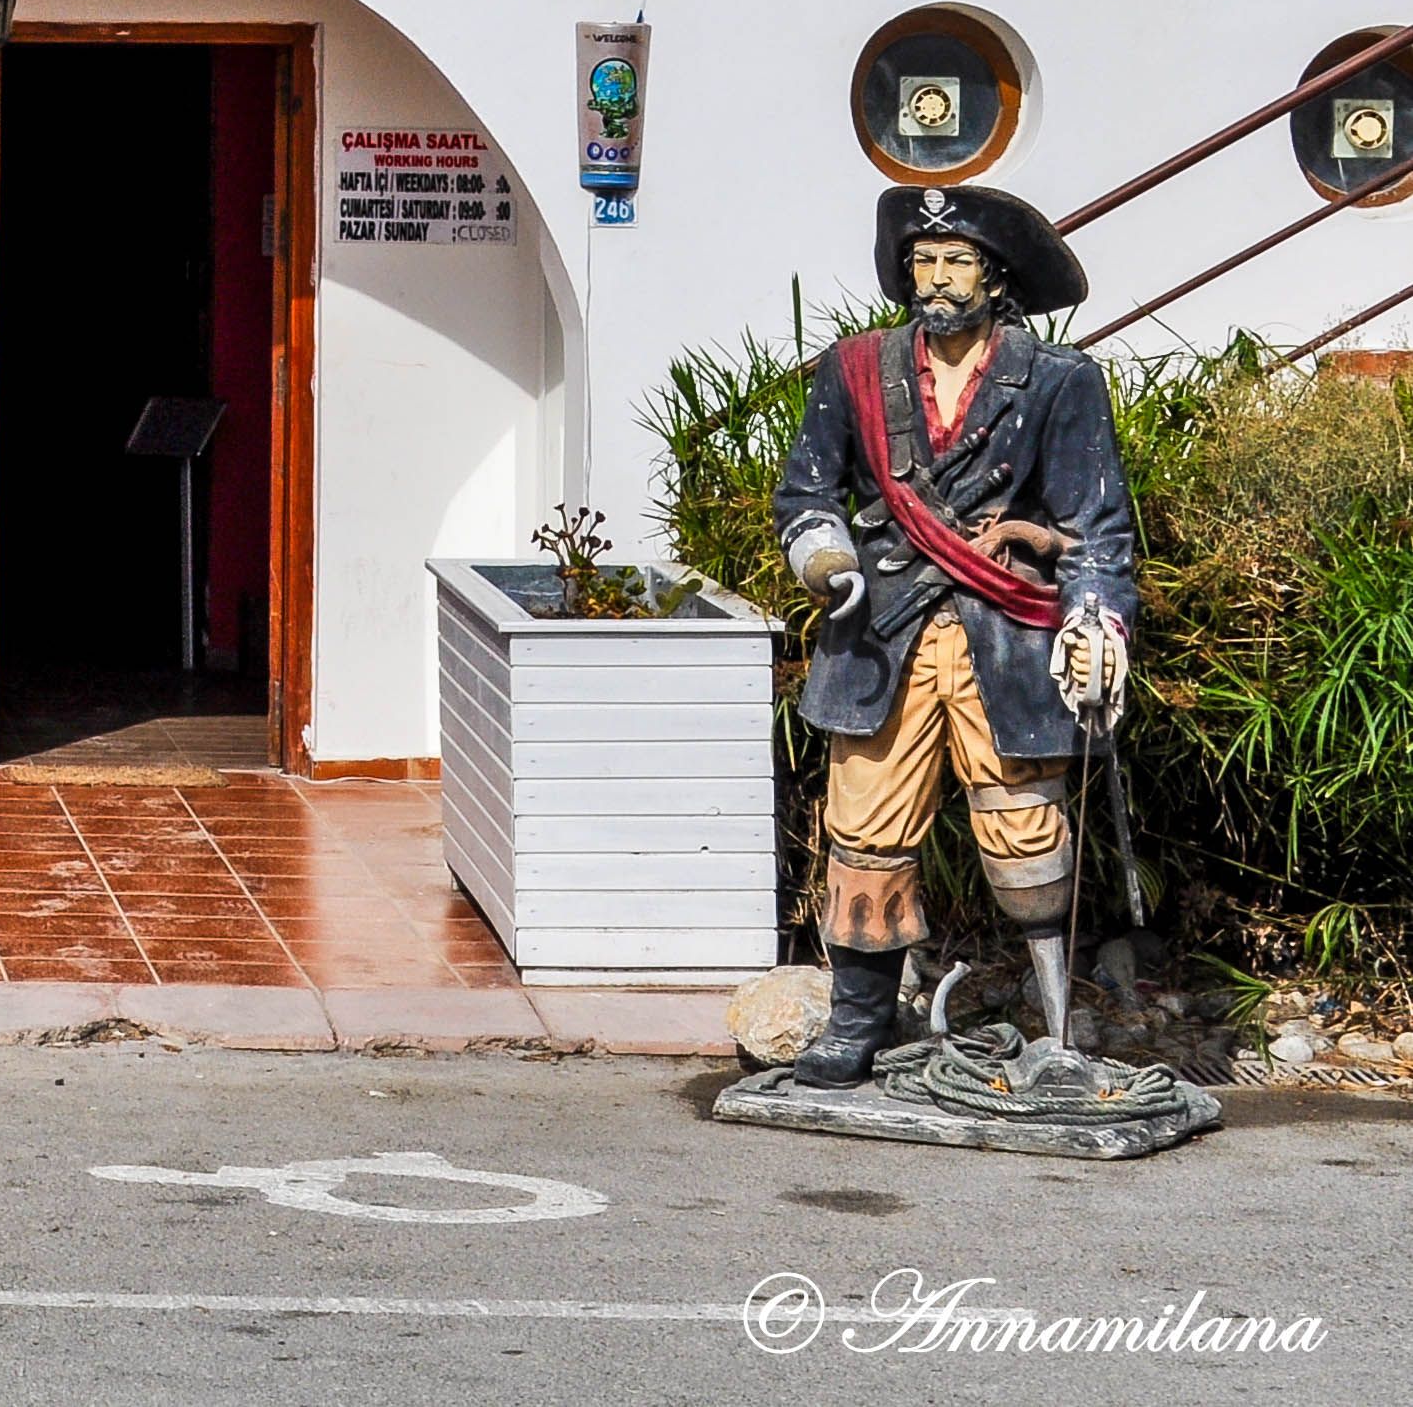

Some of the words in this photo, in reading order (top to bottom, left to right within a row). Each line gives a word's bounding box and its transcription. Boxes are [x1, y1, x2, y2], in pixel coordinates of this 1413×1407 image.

[341, 132, 421, 152] ÇALIŞMA
[374, 154, 432, 167] WORKING
[436, 156, 479, 168] HOURS
[340, 172, 372, 191] HAFTA
[395, 173, 448, 192] WEEKDAYS
[340, 195, 394, 219] CUMARTESİ
[401, 200, 451, 220] SATURDAY
[596, 197, 629, 218] 246
[339, 221, 375, 240] PAZAR
[384, 222, 429, 242] SUNDAY
[457, 225, 511, 241] CLOSED
